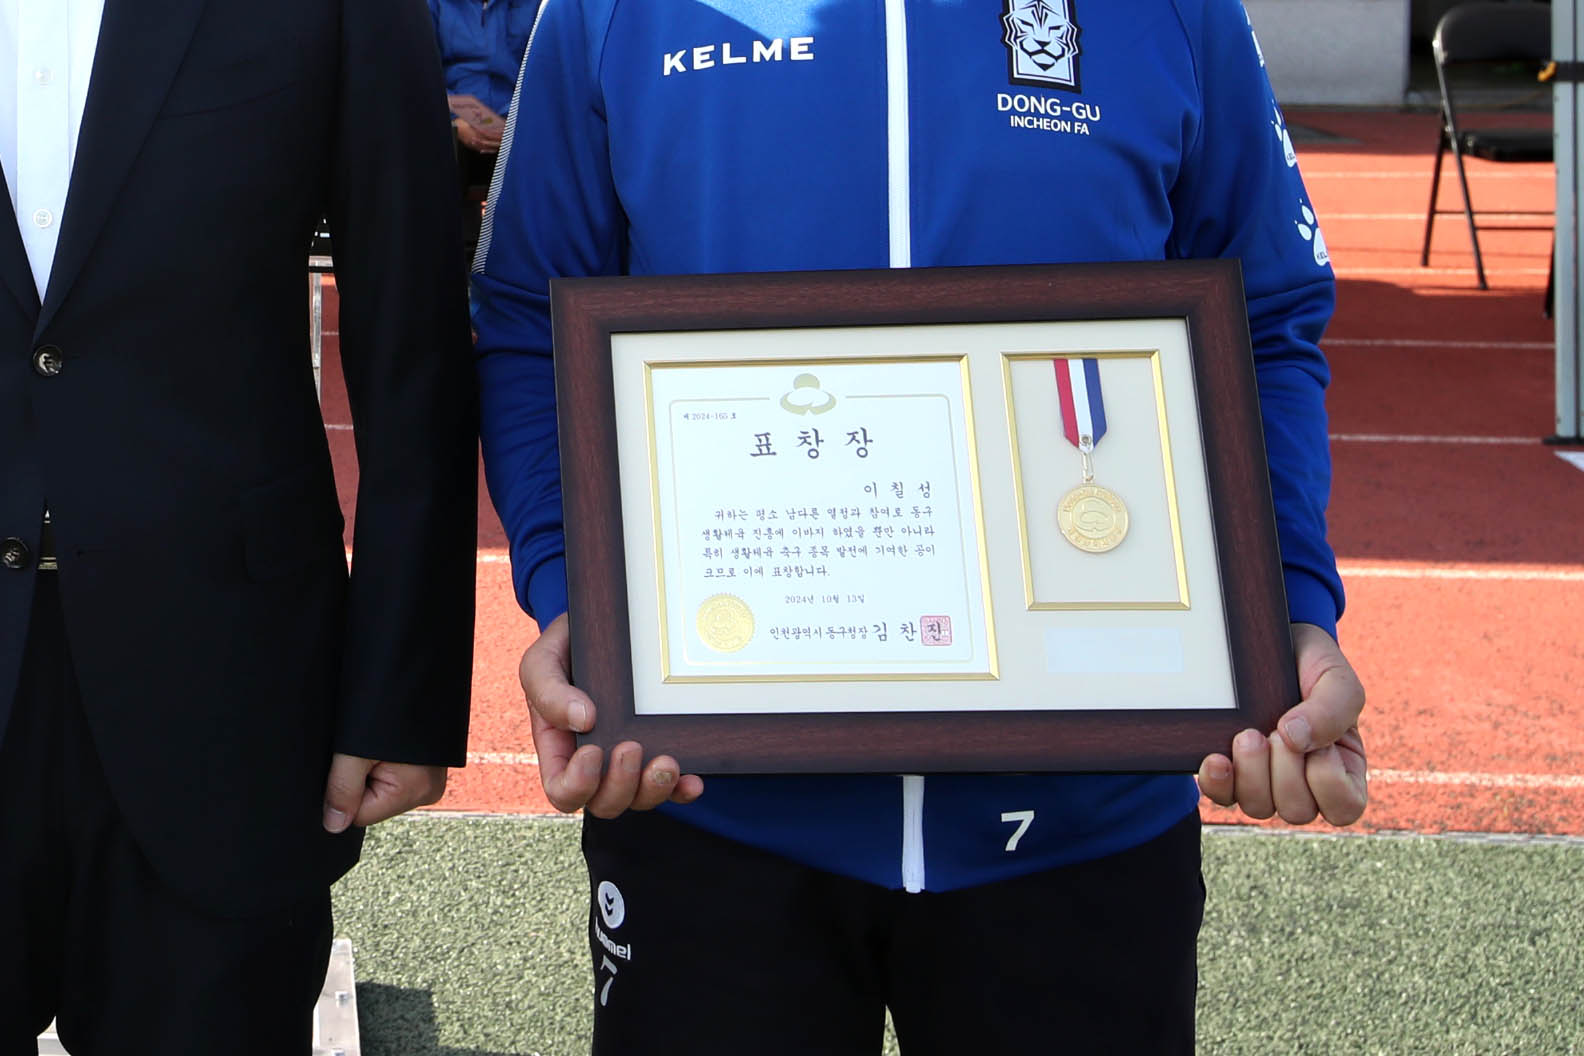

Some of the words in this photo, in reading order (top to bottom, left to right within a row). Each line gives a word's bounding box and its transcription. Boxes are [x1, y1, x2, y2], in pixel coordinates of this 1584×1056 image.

[663, 36, 815, 77] KELME
[996, 92, 1102, 122] DONG-GU
[1009, 114, 1072, 133] INCHEON
[1073, 120, 1091, 136] FA
[786, 508, 819, 520] 남다른
[911, 506, 932, 518] 동구
[703, 528, 744, 541] 생활체육
[753, 528, 783, 540] 진흥에
[792, 527, 823, 538] 이바지
[901, 525, 935, 536] 아니라
[702, 547, 722, 559] 특히
[731, 547, 773, 559] 생활체육
[780, 546, 801, 558] 축구
[808, 546, 829, 558] 종목
[836, 545, 867, 558] 발전에
[876, 545, 907, 557] 기여한
[915, 544, 935, 557] 공이
[704, 568, 736, 577] 크므로
[744, 566, 763, 577] 이에
[772, 565, 829, 578] 표창합니다.
[785, 595, 813, 604] 2024년
[822, 595, 839, 603] 10월
[848, 595, 864, 603] 13일
[770, 627, 821, 640] 인천광역시
[826, 626, 868, 639] 동구청장
[1001, 811, 1034, 851] 7
[599, 954, 617, 1006] 7
